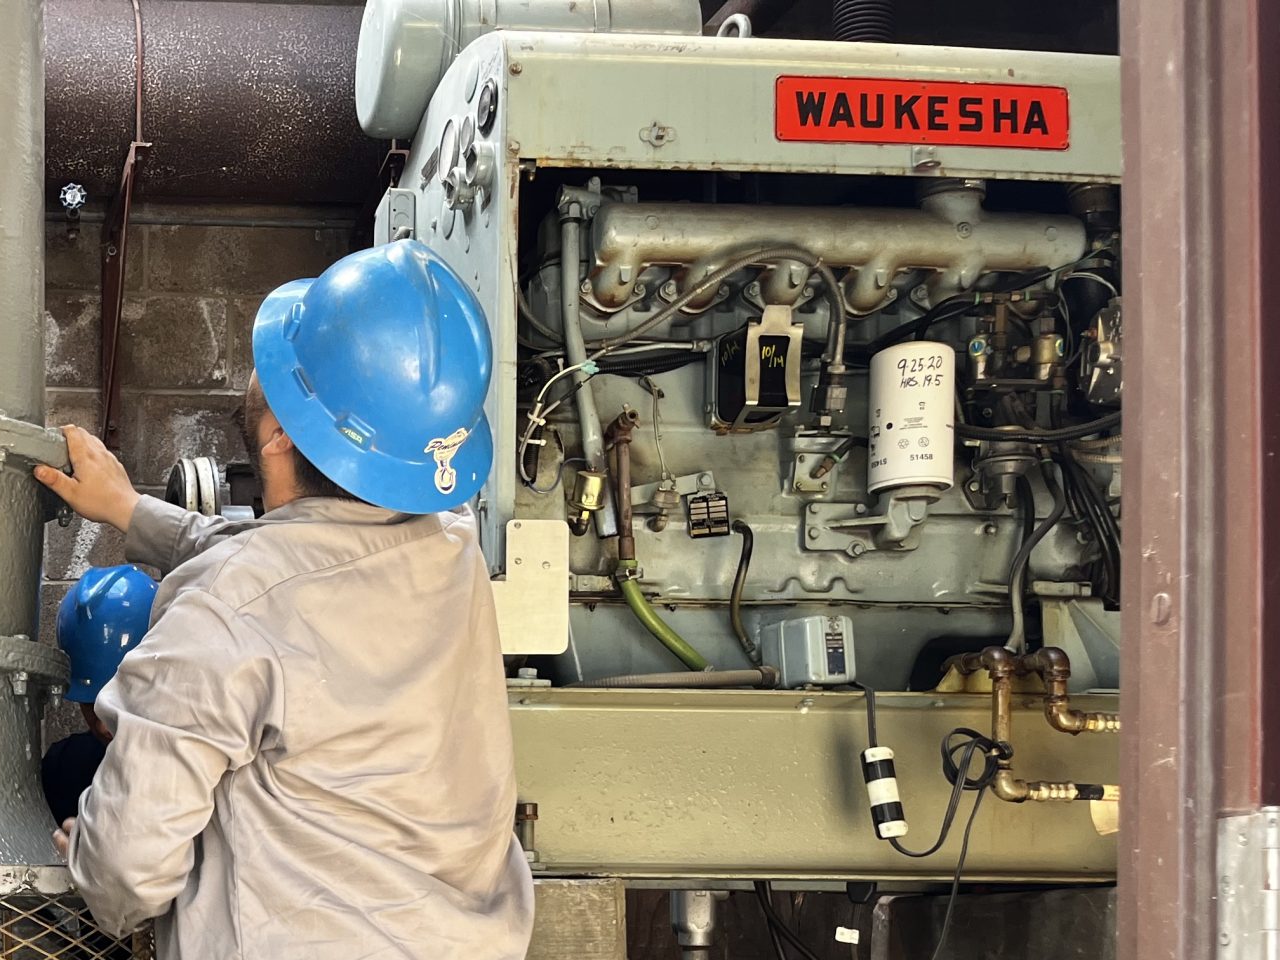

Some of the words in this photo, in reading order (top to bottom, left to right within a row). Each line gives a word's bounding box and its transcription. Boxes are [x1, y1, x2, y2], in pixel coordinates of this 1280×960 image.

[795, 90, 1049, 136] WAUKESHA
[761, 344, 785, 368] 10/14
[909, 453, 934, 461] 51458
